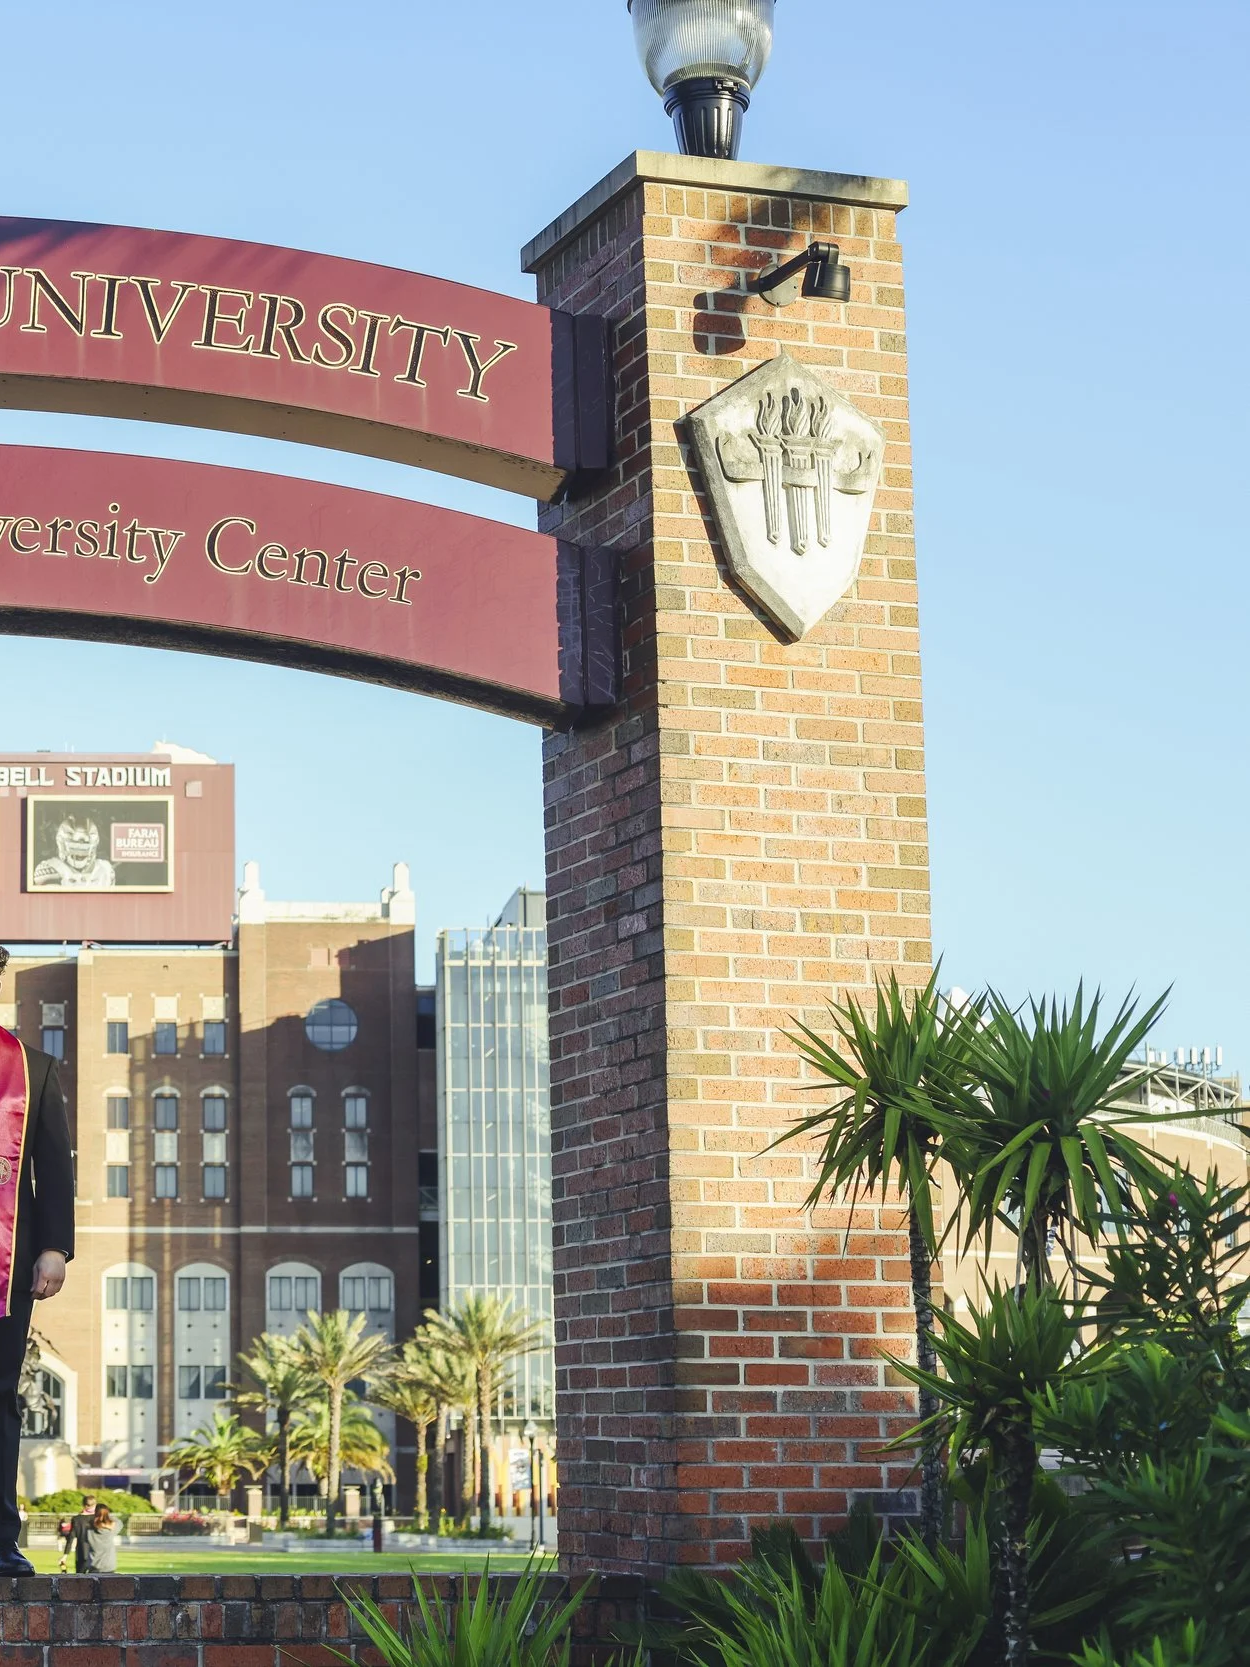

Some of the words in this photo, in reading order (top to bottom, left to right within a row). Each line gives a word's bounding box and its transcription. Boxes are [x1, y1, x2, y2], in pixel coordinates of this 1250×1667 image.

[205, 517, 421, 606] Center
[65, 766, 172, 787] STADIUM
[128, 828, 159, 838] FARM
[115, 838, 159, 848] BUREAU
